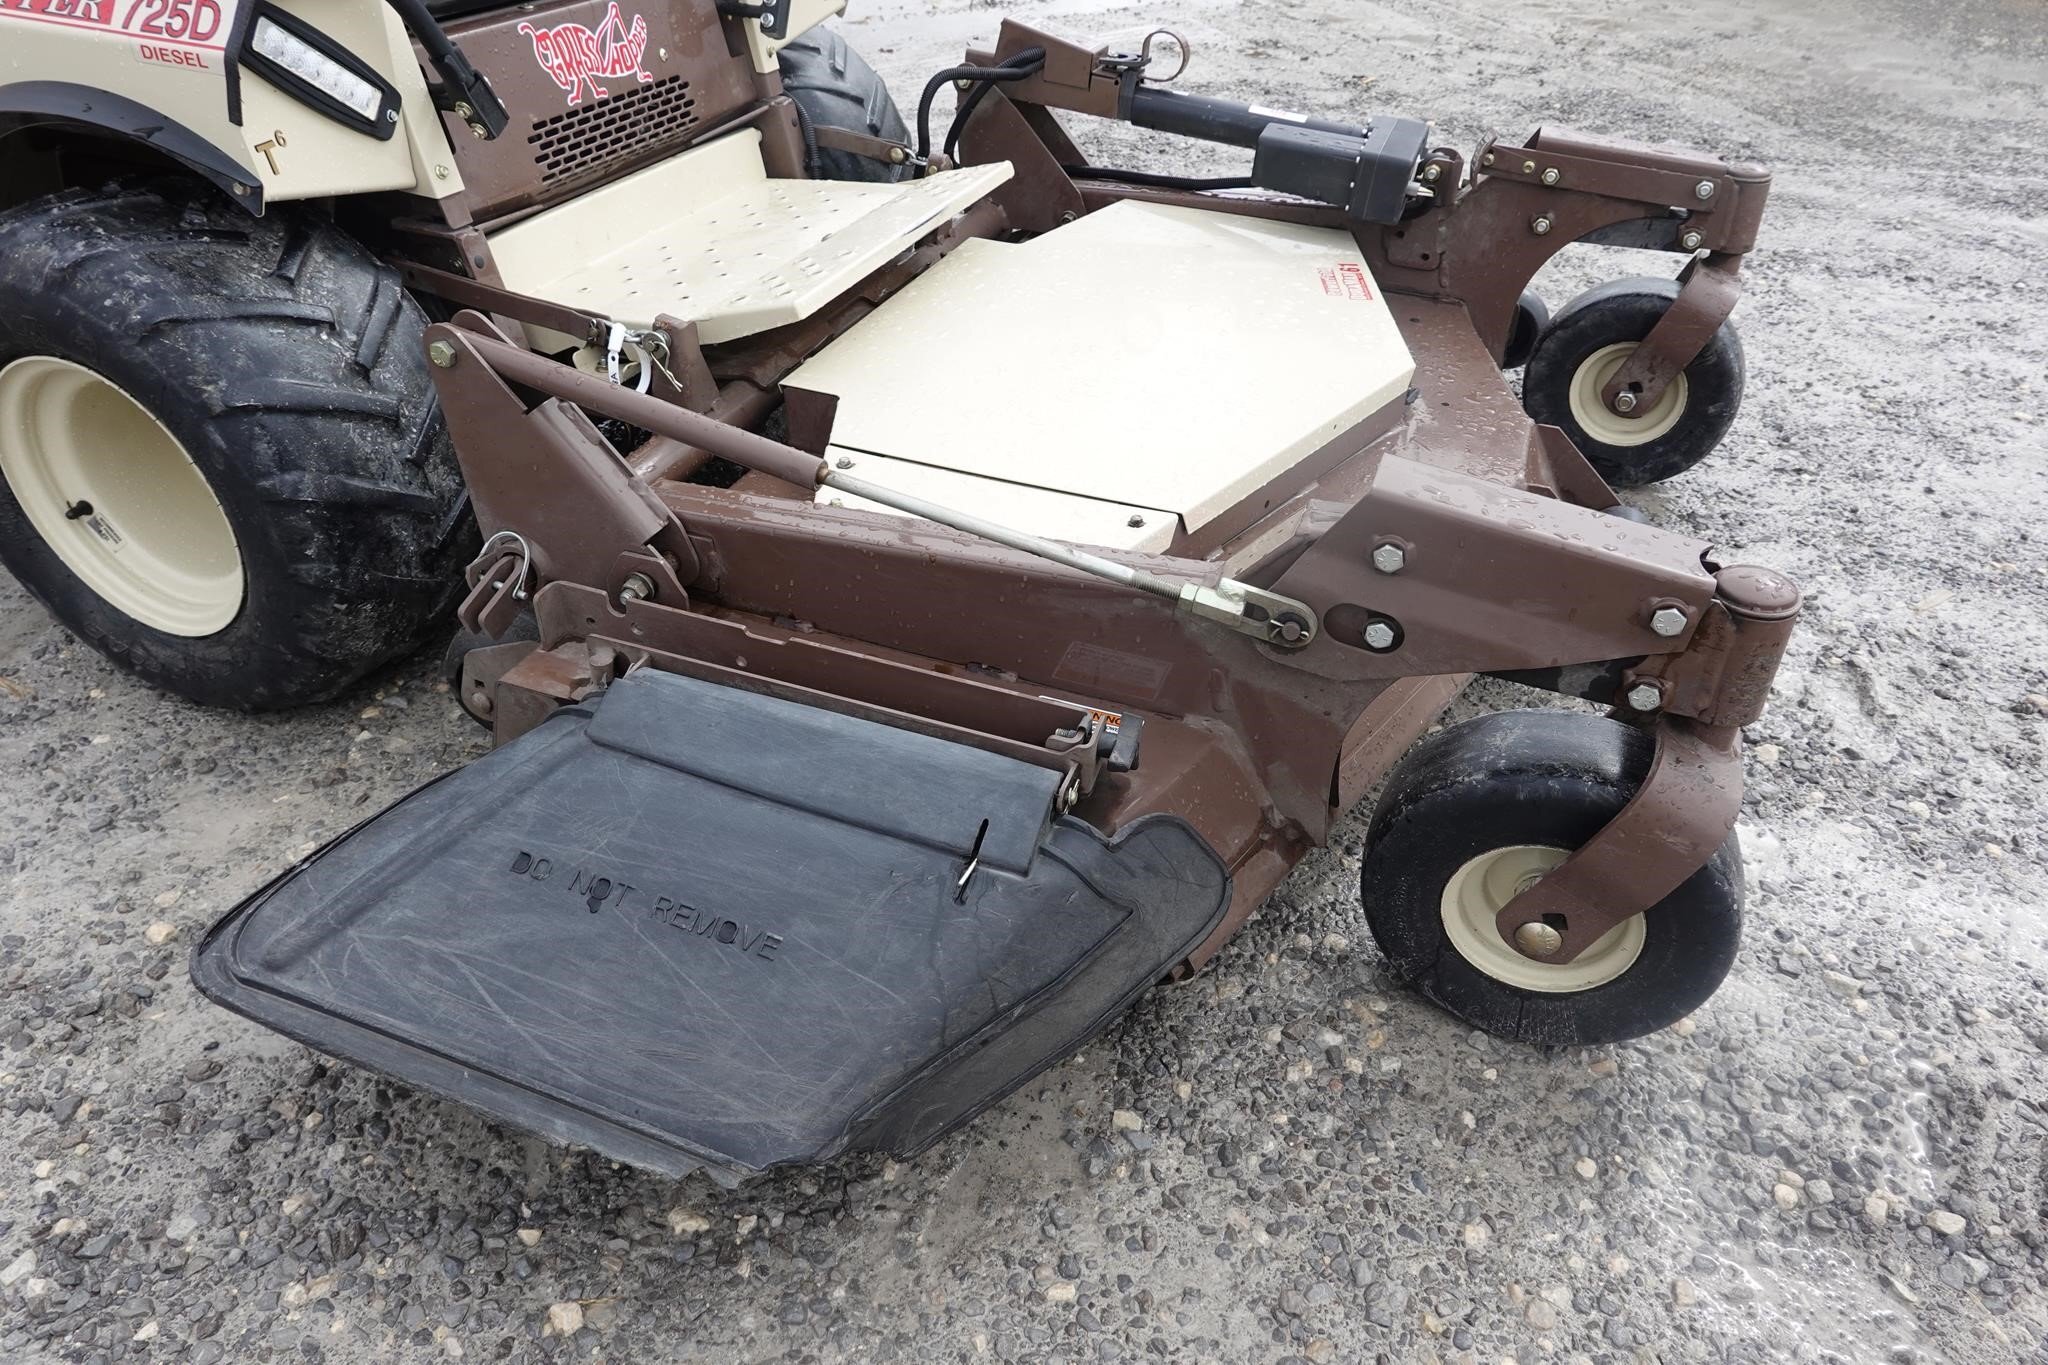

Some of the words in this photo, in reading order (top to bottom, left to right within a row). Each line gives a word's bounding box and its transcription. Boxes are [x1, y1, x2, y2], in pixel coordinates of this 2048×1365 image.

[121, 0, 221, 41] 725D
[140, 44, 209, 69] DIESEL
[517, 1, 653, 105] GRASSHOPPER
[509, 851, 552, 880] DO
[568, 870, 636, 907] NOT
[649, 896, 784, 962] REMOVE
